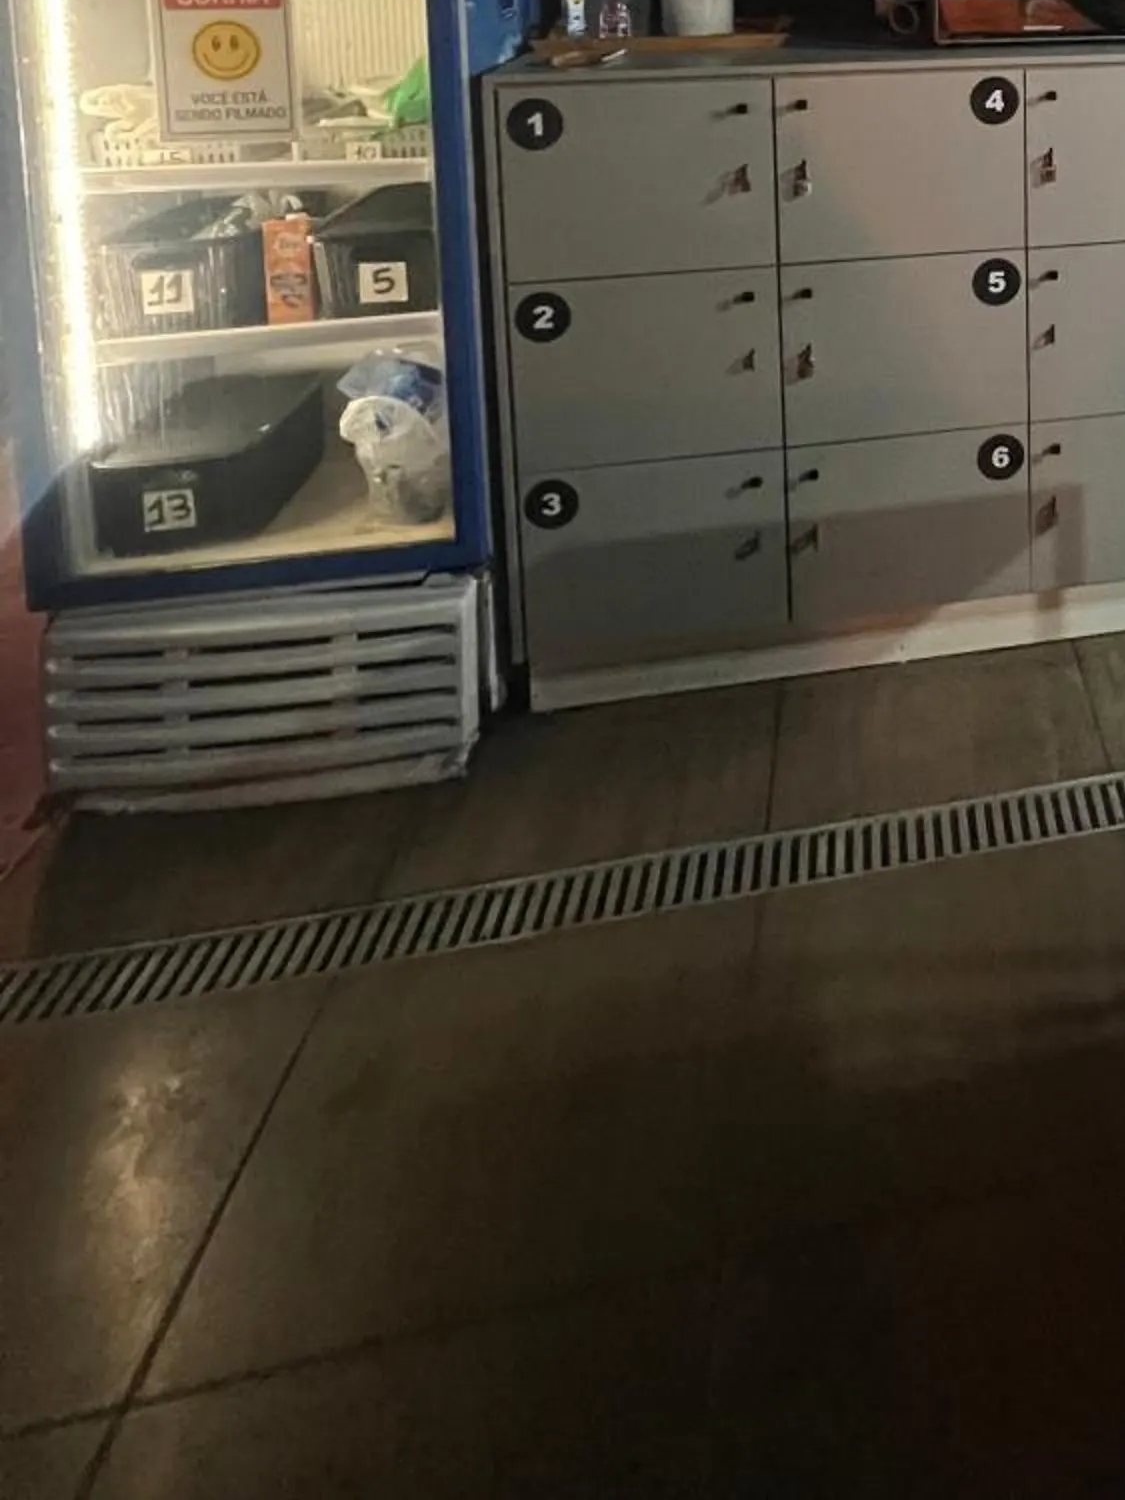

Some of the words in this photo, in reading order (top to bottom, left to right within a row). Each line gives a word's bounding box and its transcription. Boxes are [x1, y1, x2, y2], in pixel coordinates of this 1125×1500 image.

[985, 89, 1005, 112] 4
[225, 106, 287, 121] FILMADO
[527, 112, 543, 136] 1
[147, 274, 183, 307] 11
[371, 267, 395, 294] 5
[988, 271, 1006, 293] 5
[533, 305, 554, 329] 2
[991, 446, 1010, 469] 6
[147, 493, 192, 526] 13
[542, 493, 562, 516] 3
